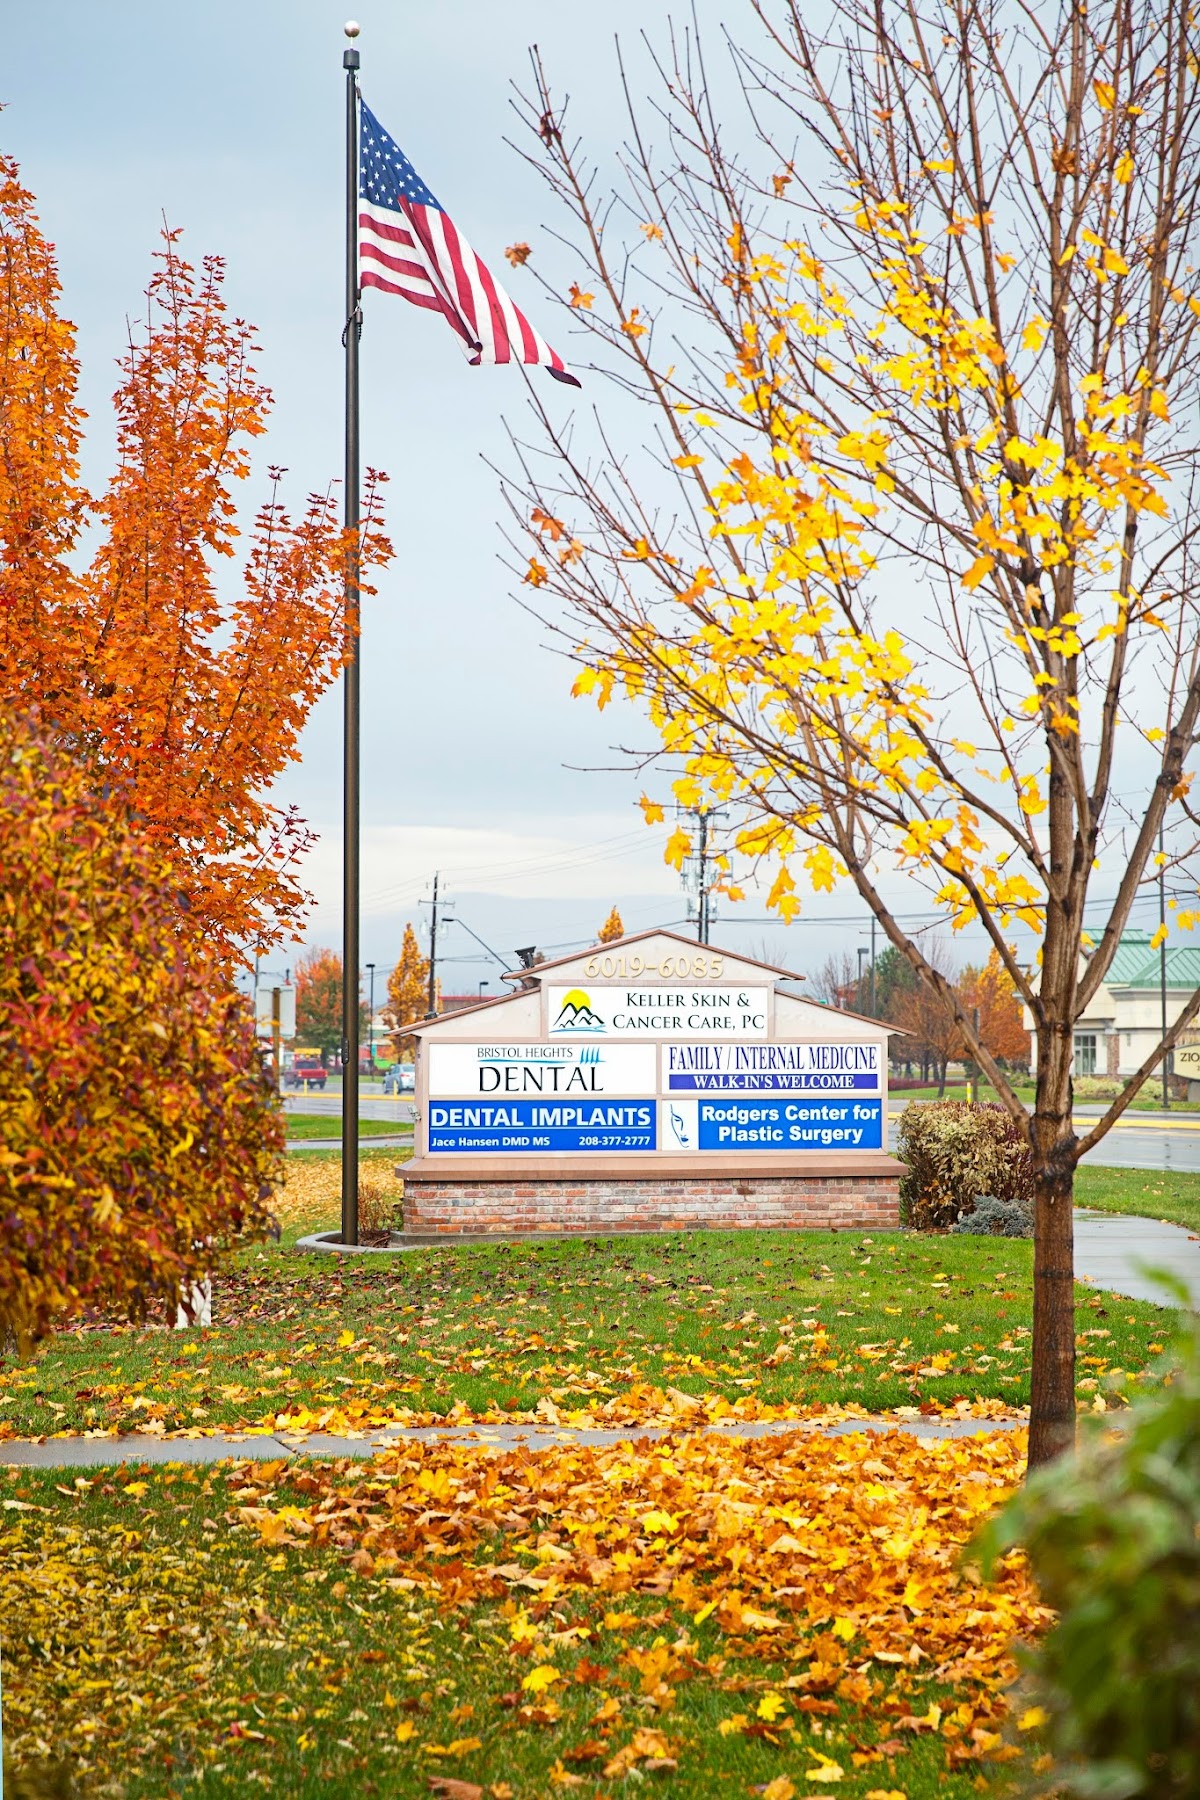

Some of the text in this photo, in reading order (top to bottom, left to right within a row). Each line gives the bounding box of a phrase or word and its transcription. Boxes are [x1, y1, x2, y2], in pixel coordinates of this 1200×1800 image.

[583, 956, 724, 978] 6019-6085
[626, 993, 749, 1007] KELLER SKIN &
[613, 1014, 765, 1030] CANCER CARE, PC
[477, 1047, 573, 1058] BRISTOL HEIGHTS
[669, 1046, 723, 1070] FAMILY
[735, 1046, 805, 1070] INTERNAL
[808, 1046, 877, 1070] MEDICINE
[479, 1066, 604, 1092] DENTAL
[693, 1075, 855, 1089] WALK-IN'S WELCOME
[431, 1107, 651, 1127] DENTAL IMPLANTS
[702, 1104, 879, 1124] Rodgers Center for
[431, 1136, 550, 1147] Jace Hansen DMD MS
[579, 1136, 651, 1146] 208-377-2777
[718, 1125, 863, 1144] Plastic Surgery
